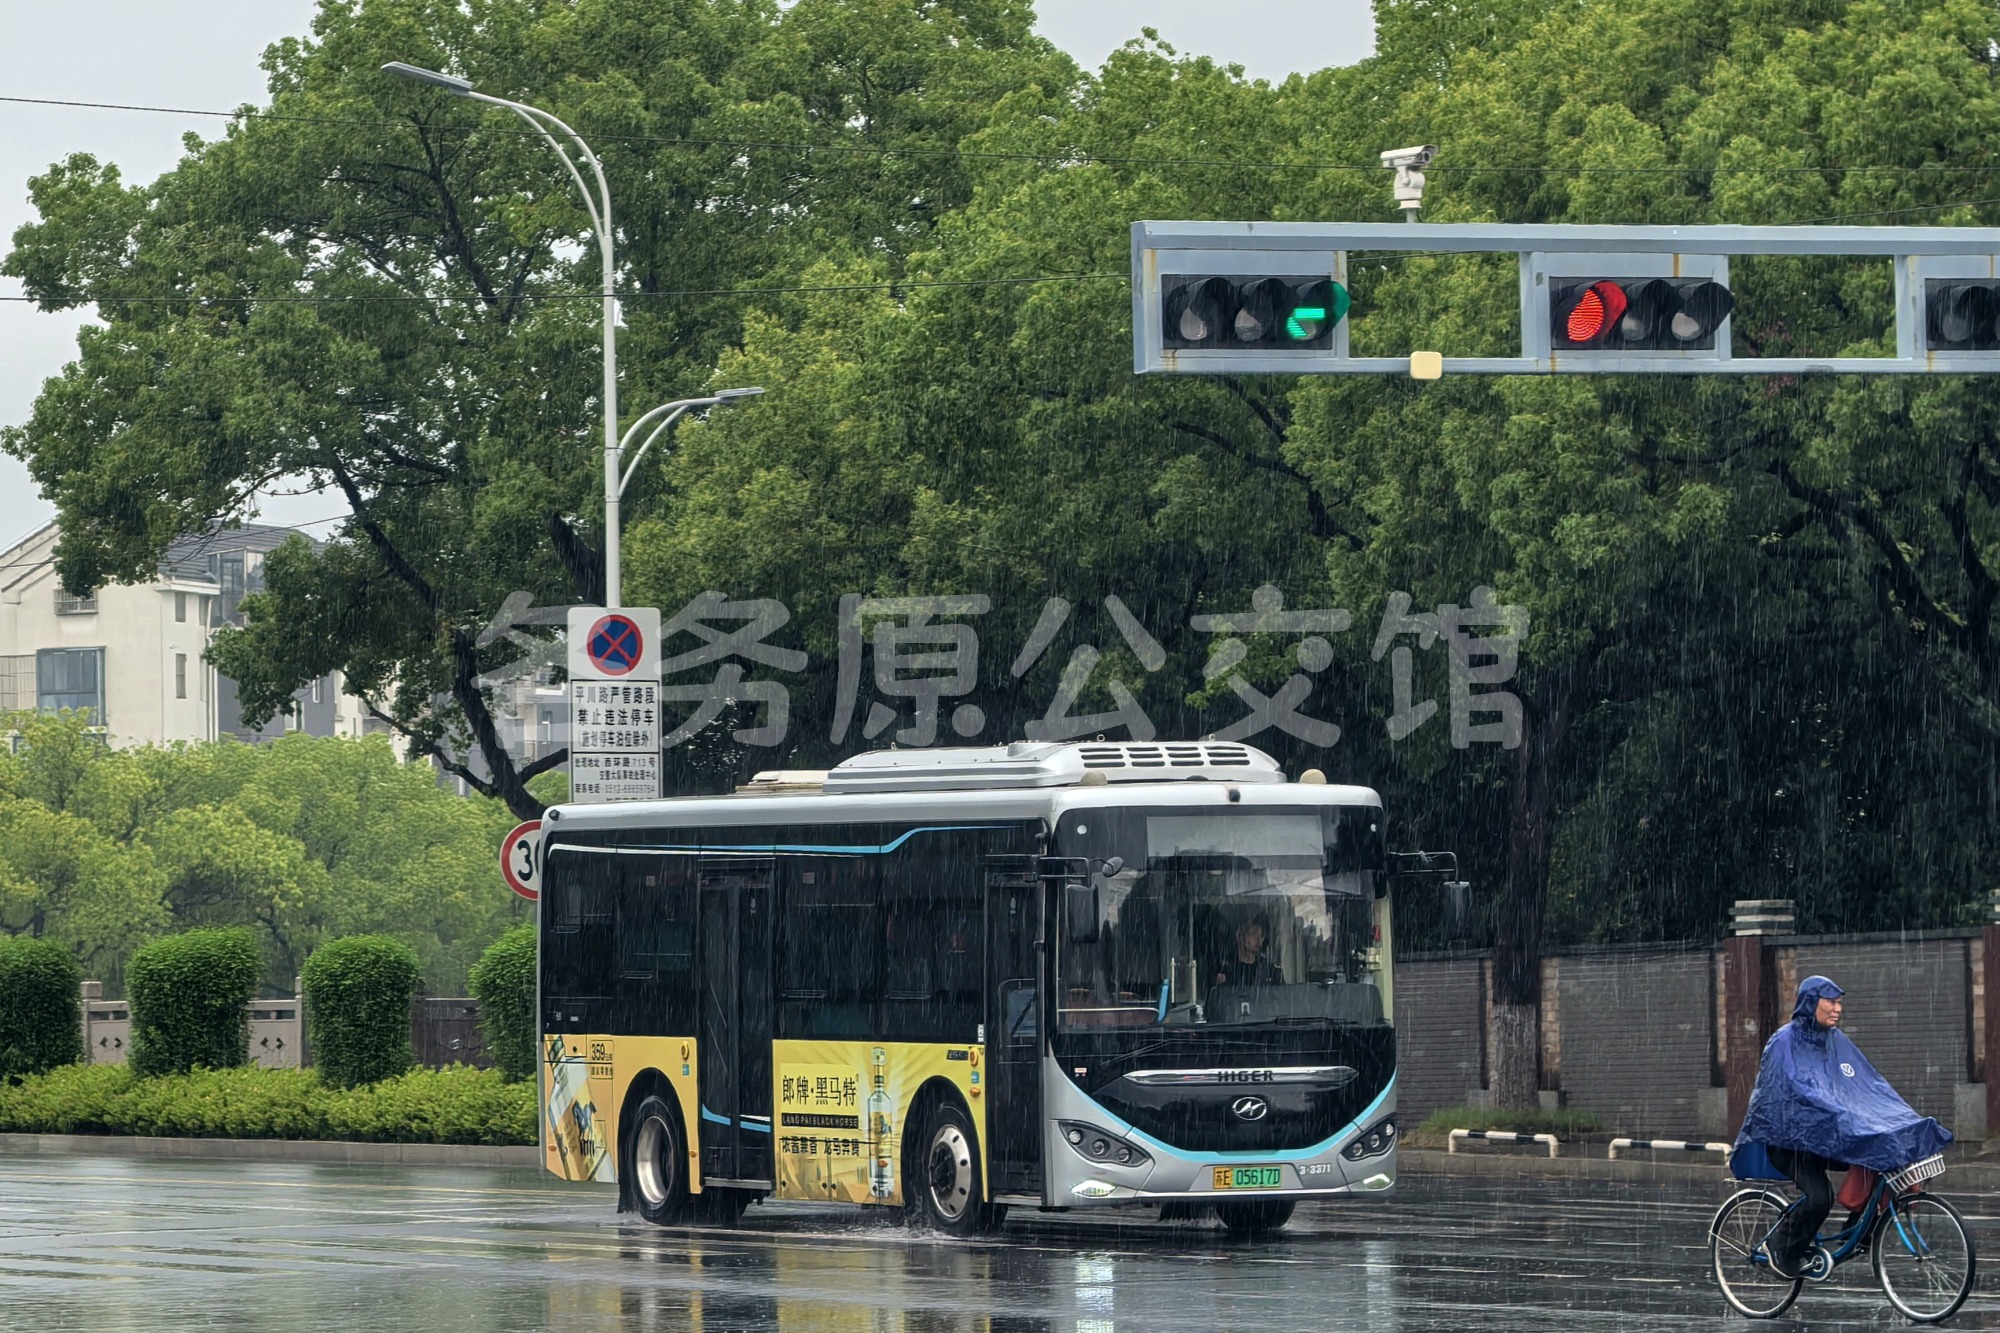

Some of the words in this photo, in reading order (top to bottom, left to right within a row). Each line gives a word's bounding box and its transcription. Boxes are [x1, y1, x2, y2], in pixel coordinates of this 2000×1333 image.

[577, 708, 654, 726] 禁止违法停车
[518, 840, 541, 881] 3
[1217, 1070, 1274, 1082] HIGER
